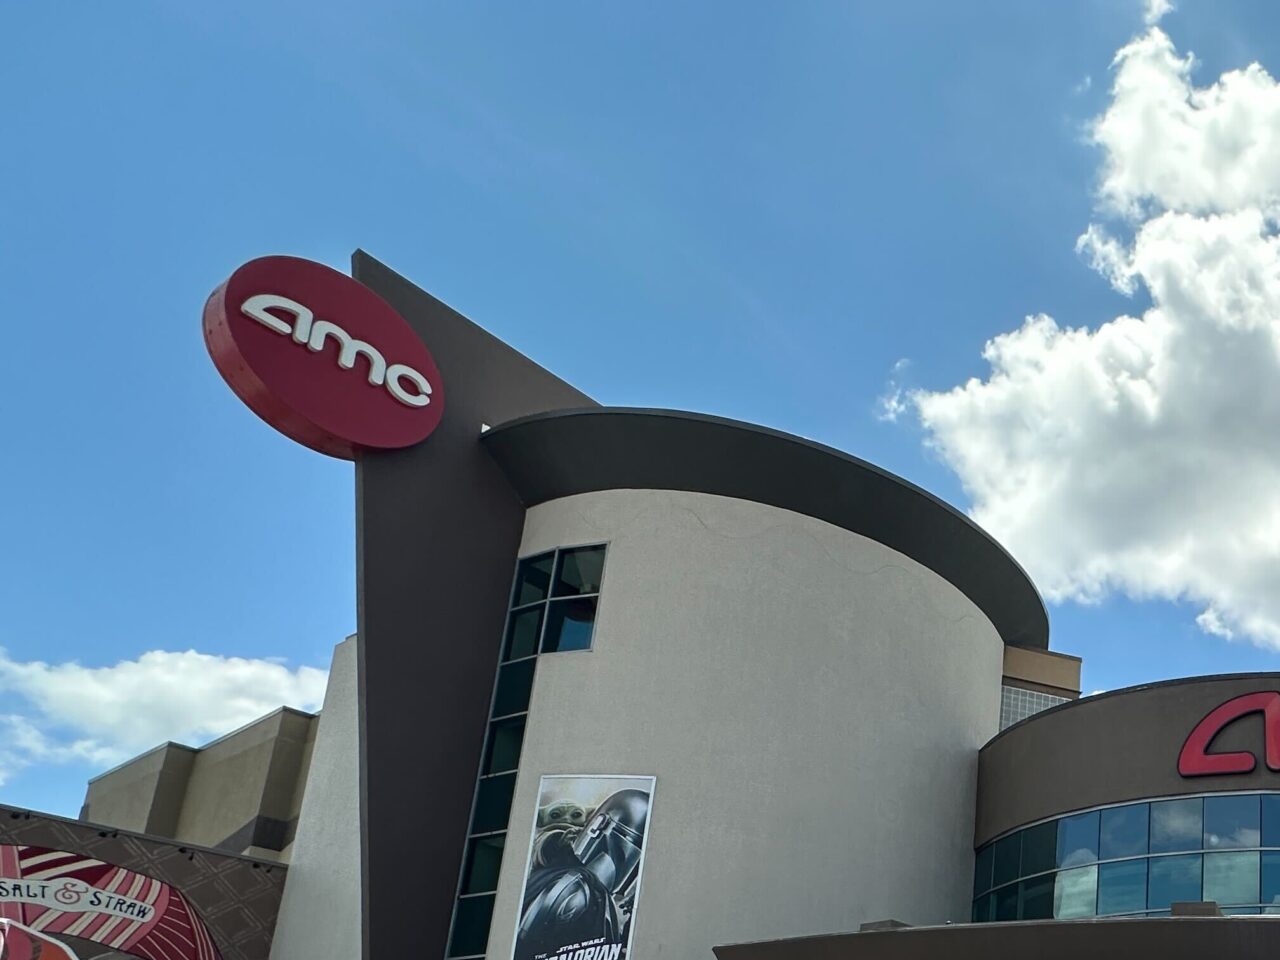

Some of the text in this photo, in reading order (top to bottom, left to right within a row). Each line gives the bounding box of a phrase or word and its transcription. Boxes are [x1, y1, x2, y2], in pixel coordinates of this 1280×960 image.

[0, 881, 152, 919] SALT & STRAW
[556, 937, 606, 954] STAR WARS
